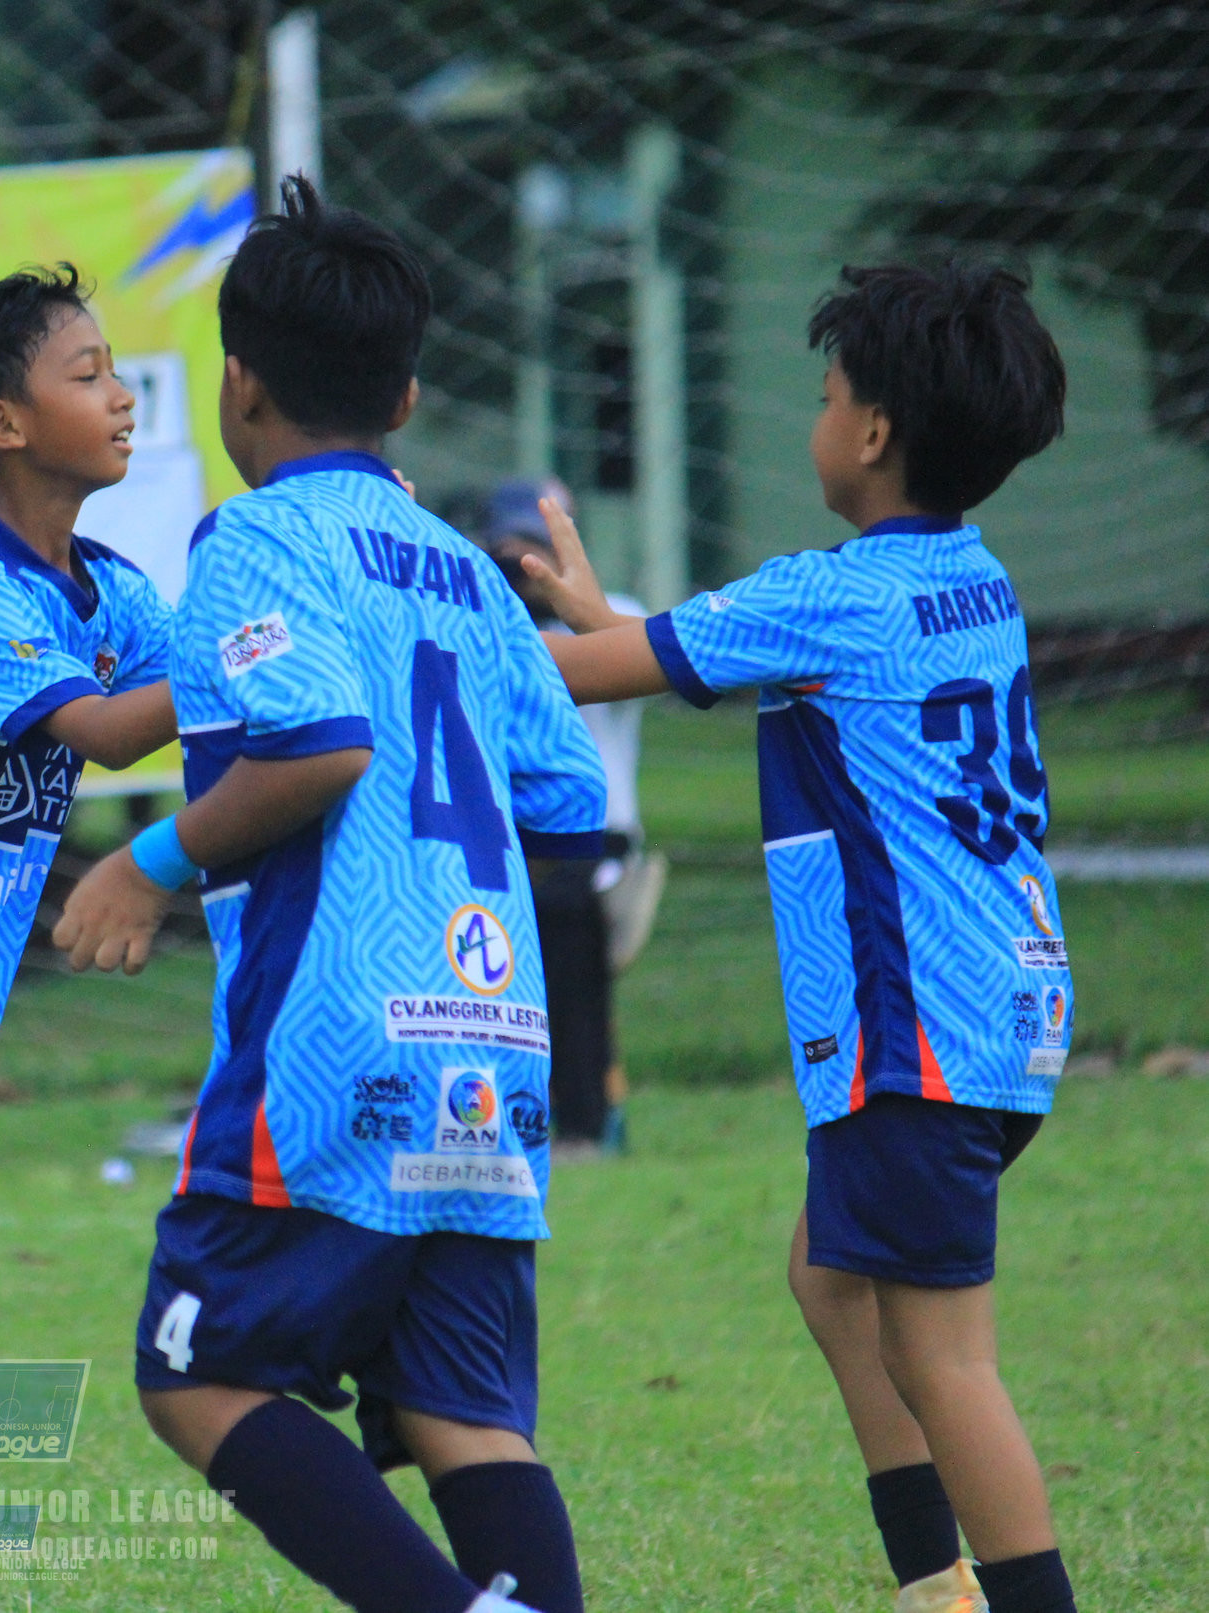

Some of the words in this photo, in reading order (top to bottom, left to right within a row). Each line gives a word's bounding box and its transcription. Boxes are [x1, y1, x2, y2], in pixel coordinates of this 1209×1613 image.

[409, 640, 512, 893] 4
[920, 664, 1050, 866] 39
[390, 1000, 504, 1023] CV.ANGGREK
[442, 1128, 498, 1144] RAN
[155, 1290, 202, 1374] 4
